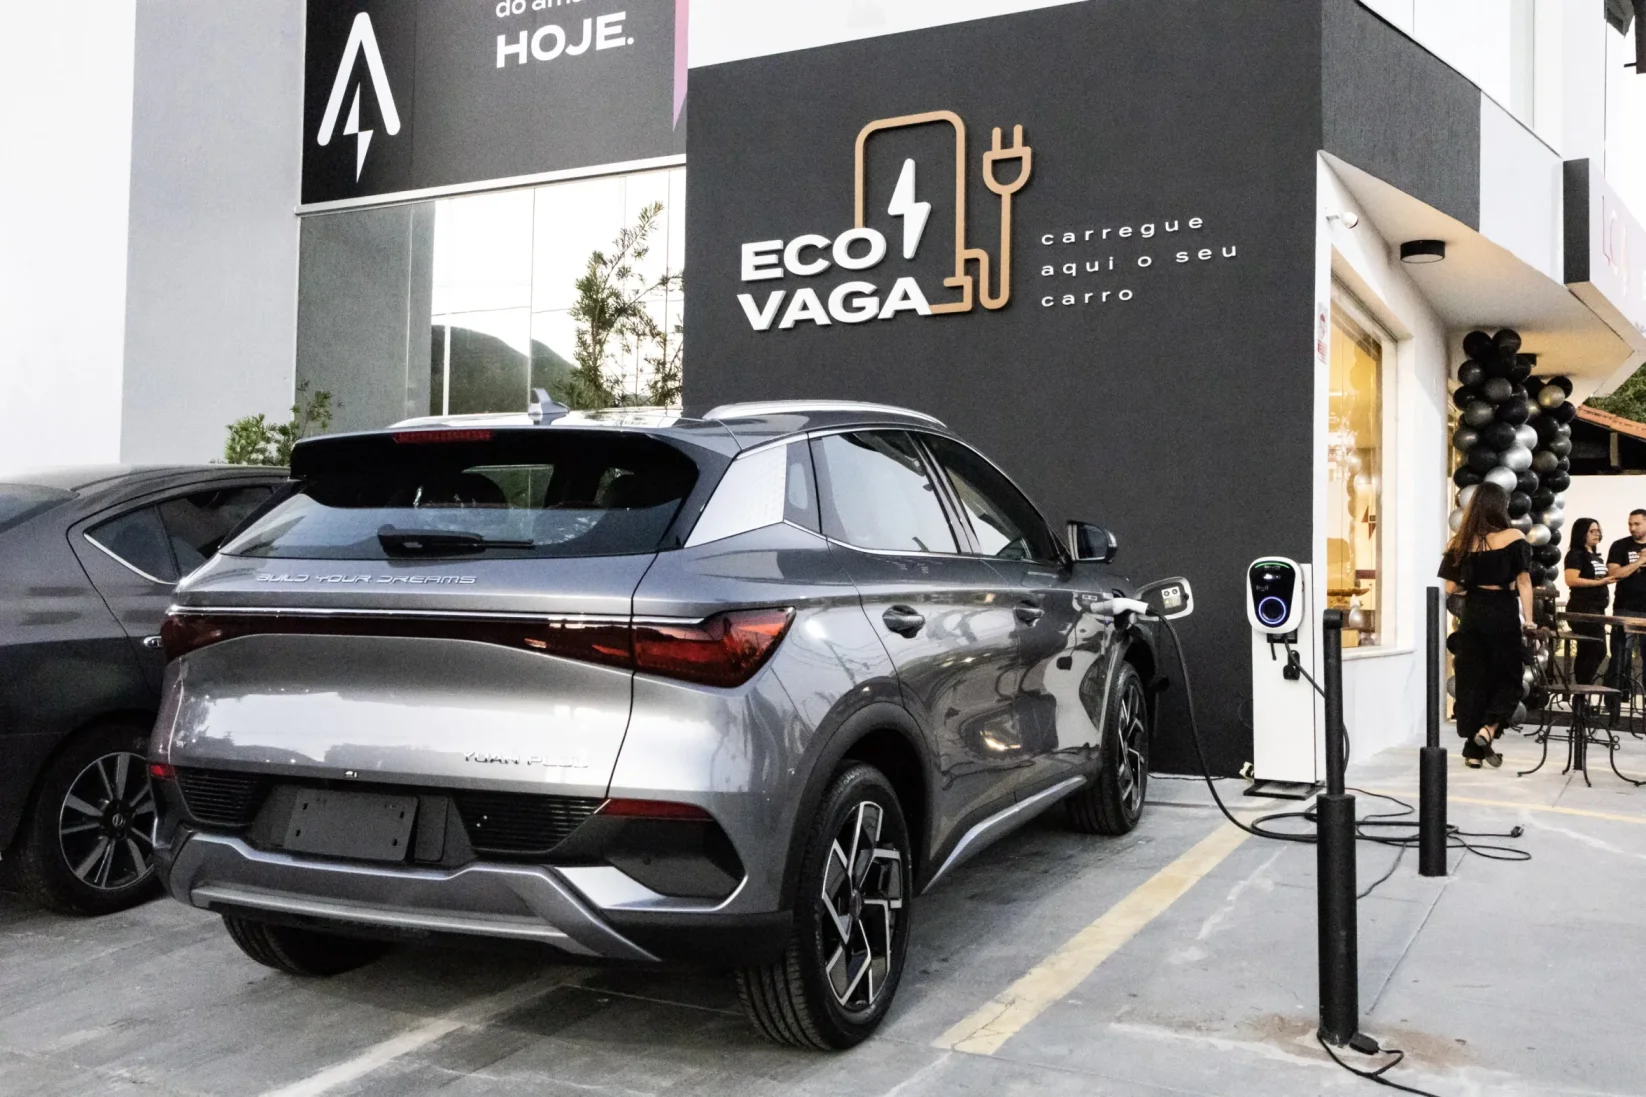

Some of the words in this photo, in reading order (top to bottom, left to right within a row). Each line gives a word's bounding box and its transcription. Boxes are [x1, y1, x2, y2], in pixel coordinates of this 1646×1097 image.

[496, 11, 635, 69] HOJE.
[1040, 217, 1204, 246] carregue
[740, 226, 887, 282] ECO
[1040, 256, 1115, 277] aqui
[1137, 255, 1153, 268] o
[1175, 245, 1238, 263] seu
[736, 276, 933, 331] VAGA
[1040, 289, 1134, 307] carro
[256, 573, 308, 583] BUILD
[315, 574, 373, 584] YOUR
[376, 575, 478, 585] DREAMS
